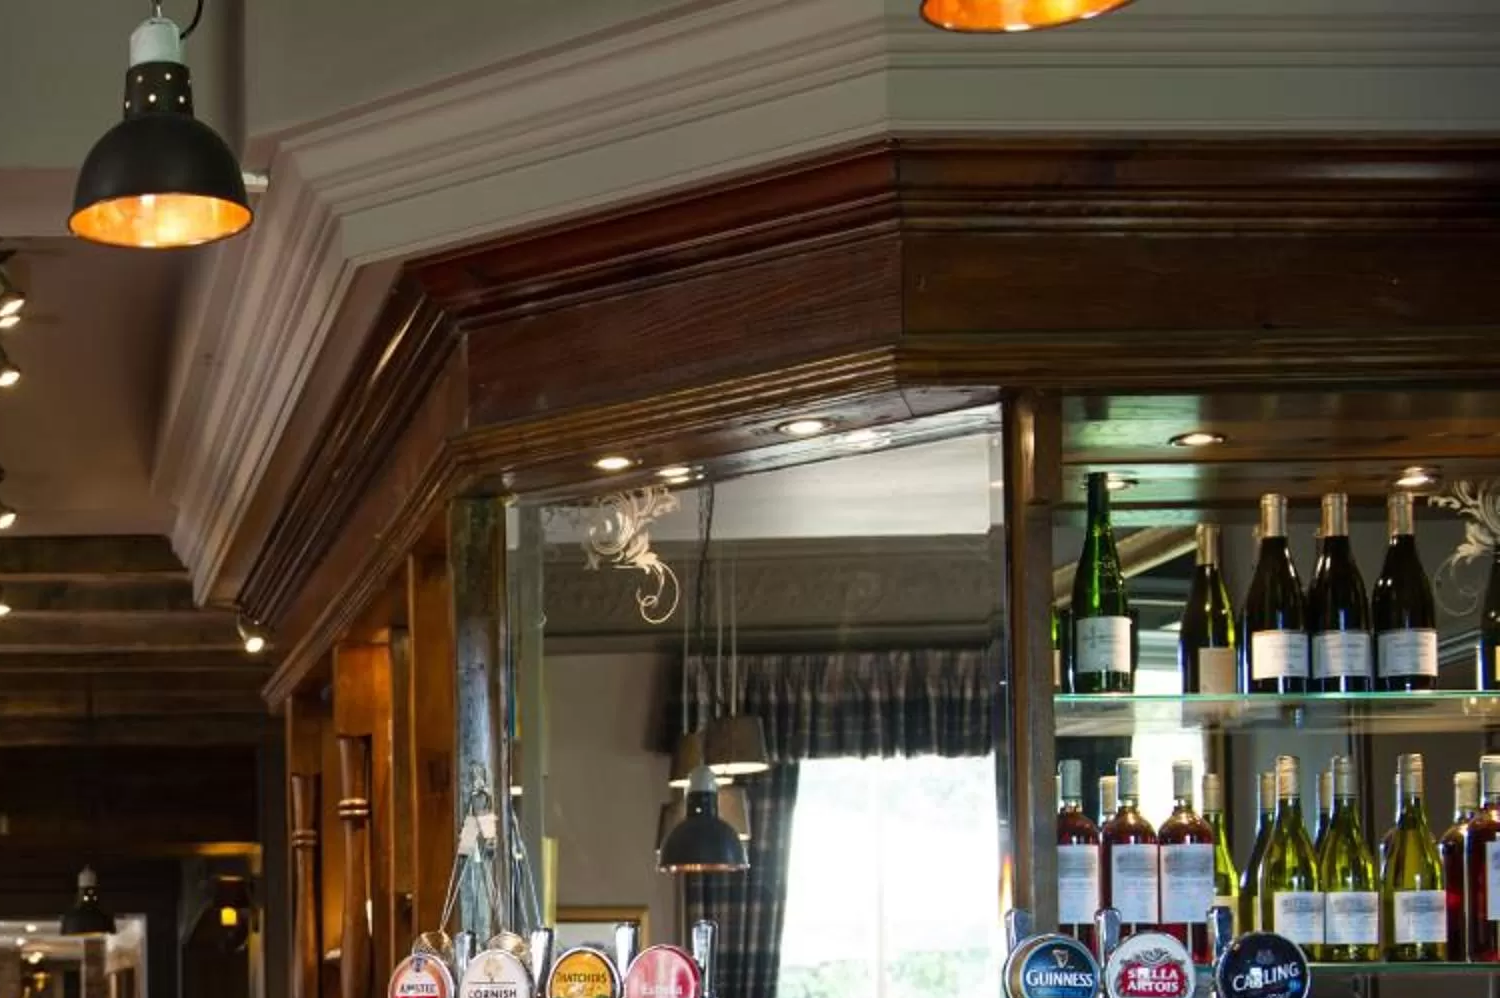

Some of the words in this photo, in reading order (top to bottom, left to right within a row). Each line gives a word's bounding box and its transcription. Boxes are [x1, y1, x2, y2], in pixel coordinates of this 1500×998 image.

[1025, 969, 1093, 987] GUINNESS
[1127, 967, 1180, 980] SLLA
[1127, 981, 1180, 993] ARTOIS
